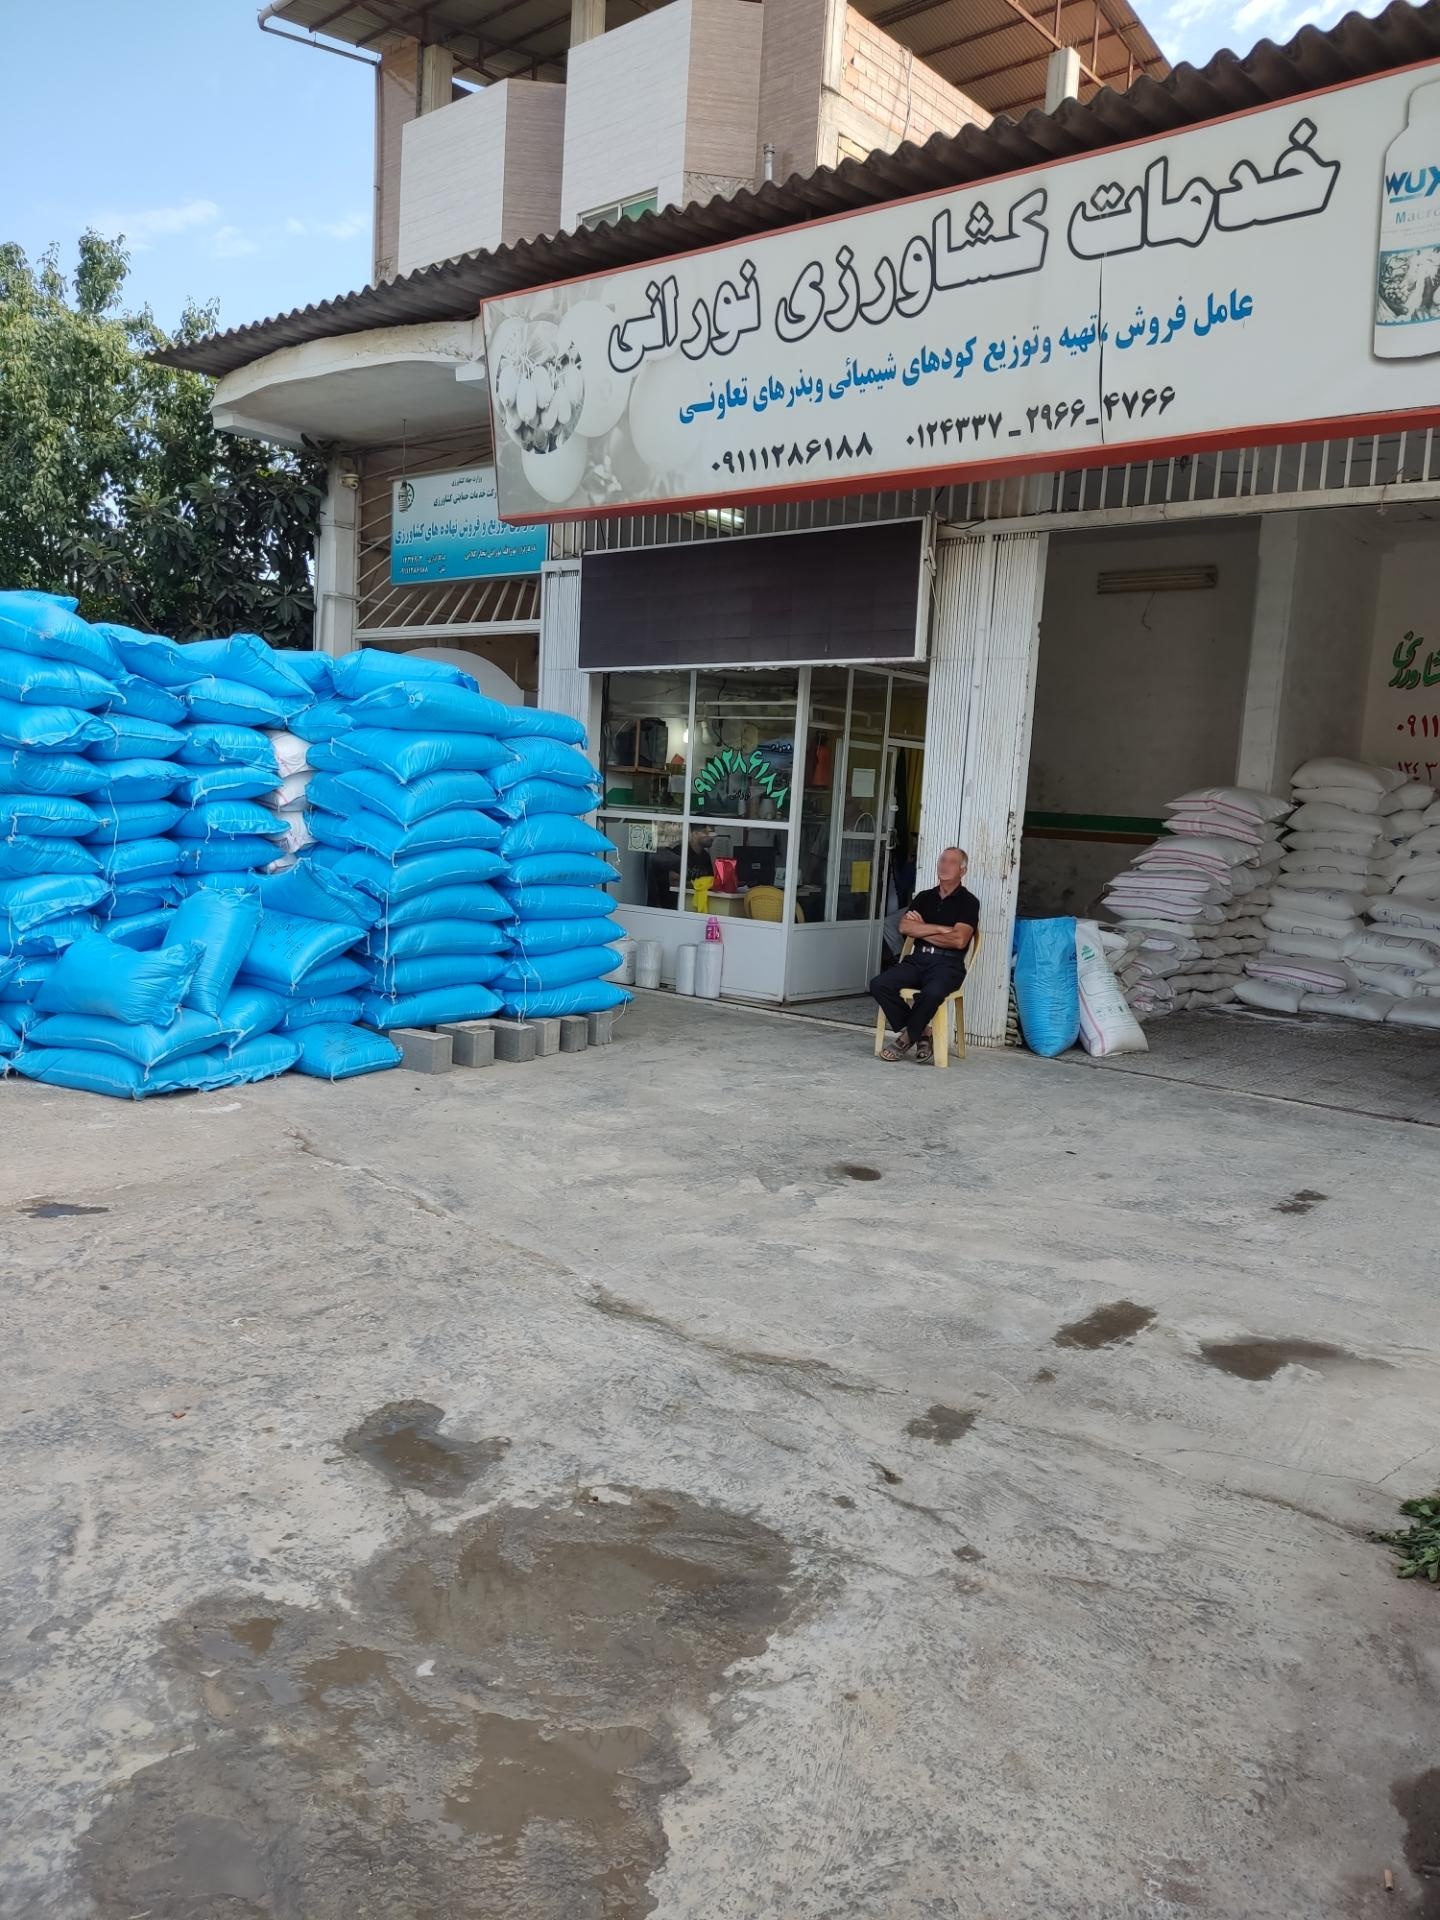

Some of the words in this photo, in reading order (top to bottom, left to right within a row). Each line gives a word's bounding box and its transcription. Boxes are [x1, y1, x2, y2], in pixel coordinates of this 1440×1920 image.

[1067, 118, 1341, 261] خدمات
[775, 188, 1049, 342] کشاورزی
[608, 259, 761, 372] نورانی
[1194, 288, 1254, 336] عامل
[829, 352, 897, 399] شیمیائی
[902, 336, 977, 386] کودهای
[679, 377, 748, 423] تعاونی
[711, 432, 873, 474] ۰۹۱۱۱۲۸۶۱۸۸
[433, 493, 453, 507] کشاورزی
[395, 522, 425, 544] کشاورزی
[459, 515, 481, 537] فروش
